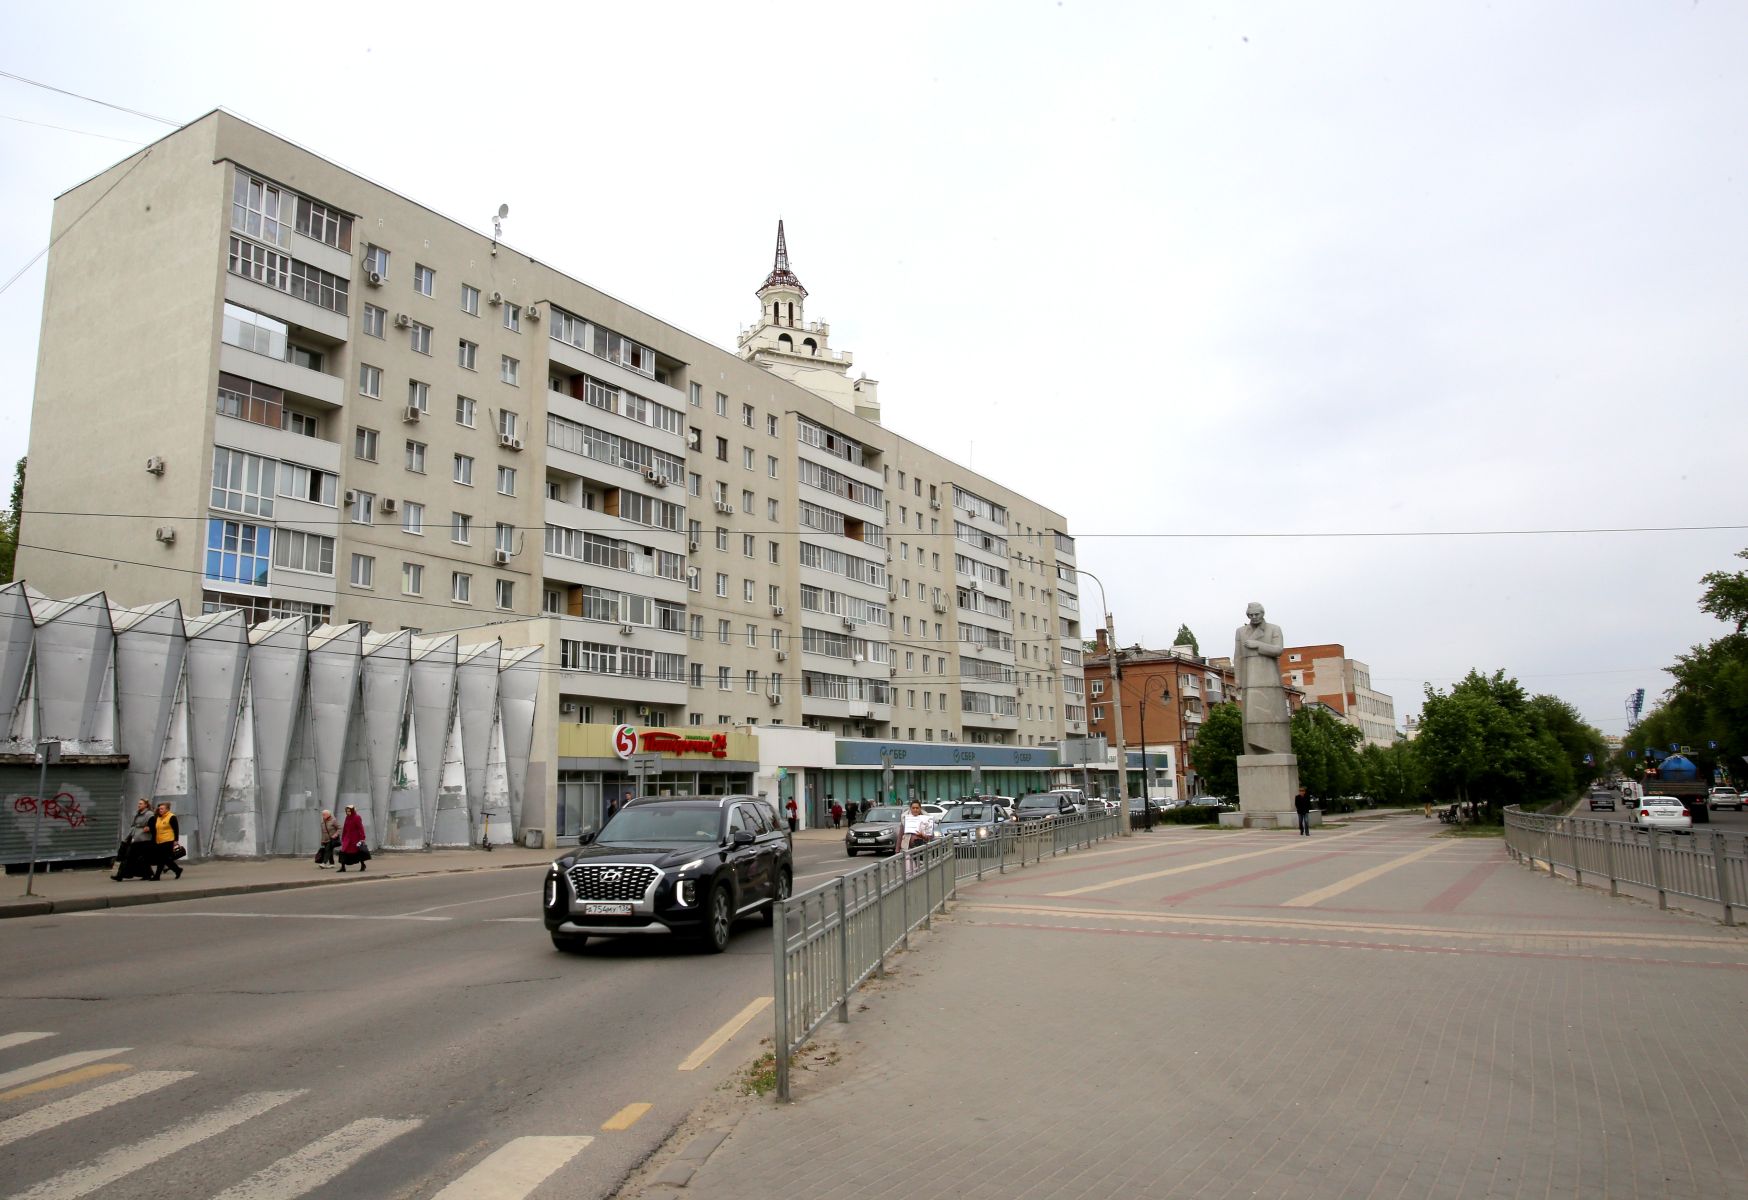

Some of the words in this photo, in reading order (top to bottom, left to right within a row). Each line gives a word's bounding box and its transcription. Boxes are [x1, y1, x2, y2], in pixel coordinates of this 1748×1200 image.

[619, 734, 633, 757] 5
[961, 751, 976, 761] СБЕР
[1019, 752, 1032, 762] СБЕР
